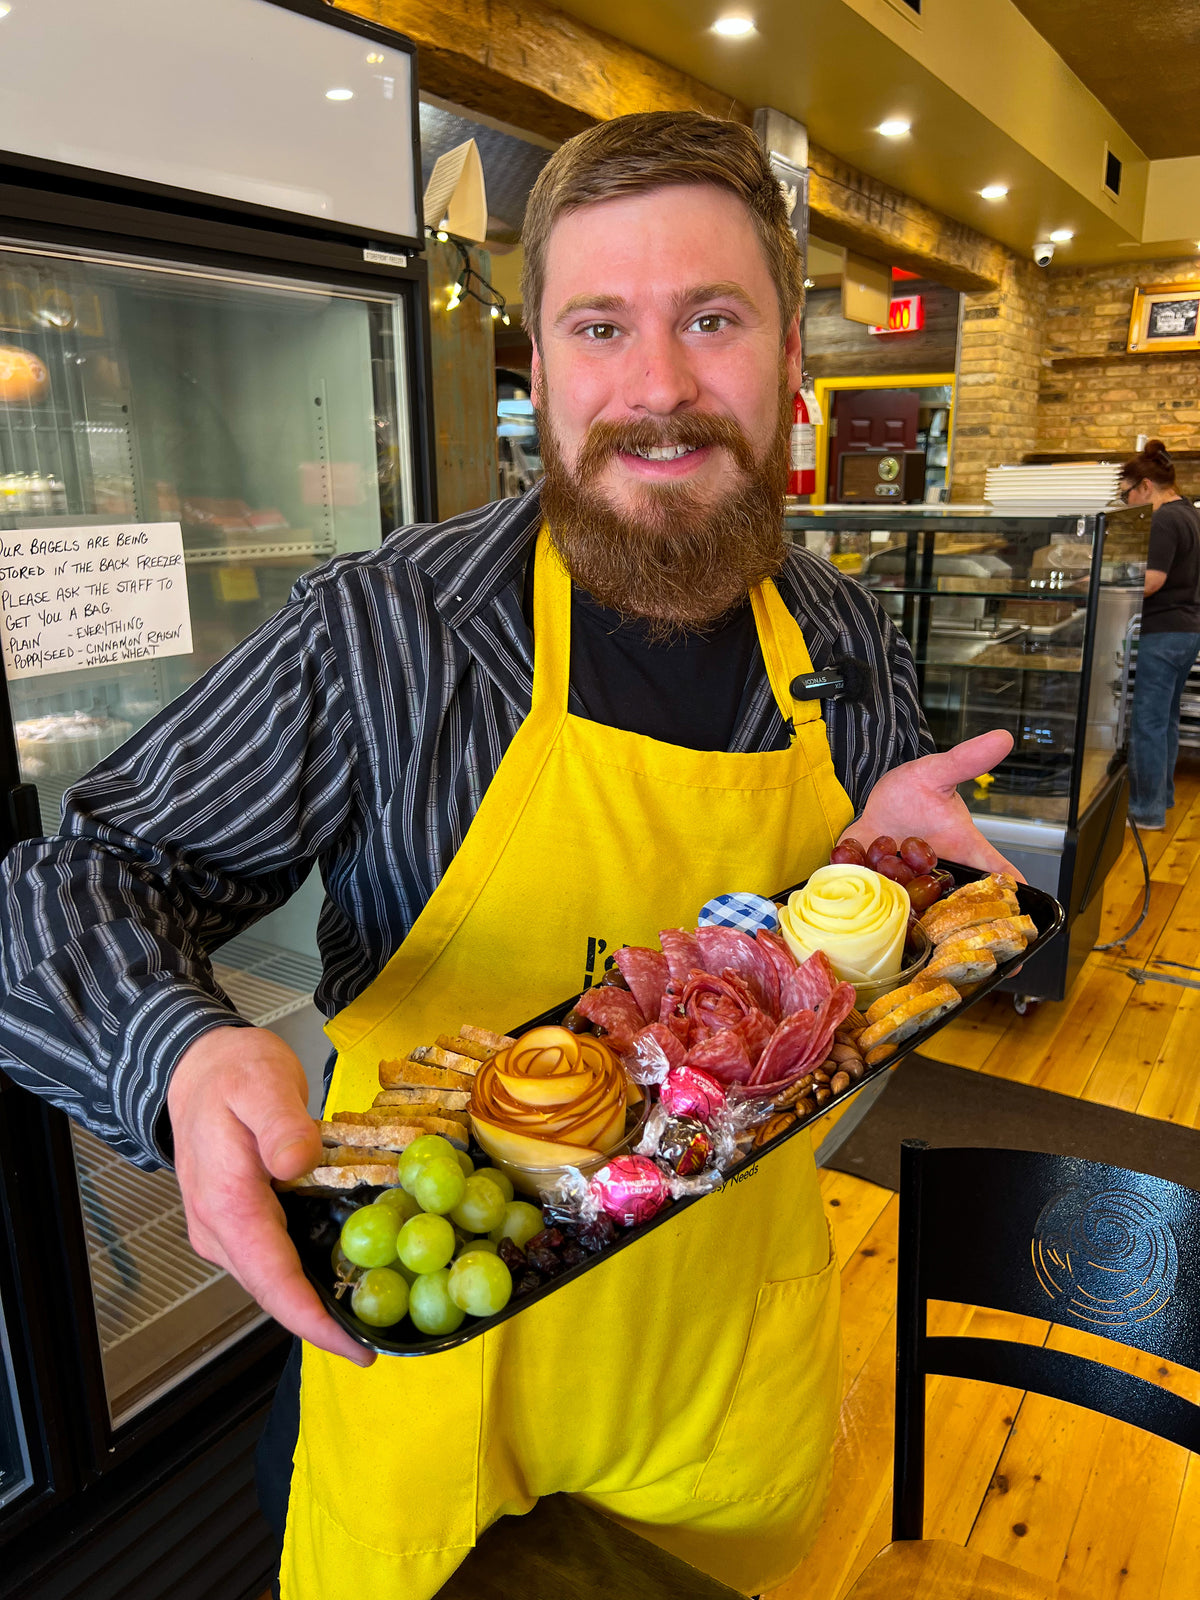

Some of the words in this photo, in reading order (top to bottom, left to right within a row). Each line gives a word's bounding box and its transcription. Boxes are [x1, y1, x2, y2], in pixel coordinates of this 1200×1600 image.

[30, 538, 80, 555] BAGELS
[87, 536, 110, 549] ARE
[116, 531, 149, 547] BEING
[0, 566, 45, 580] STORED
[54, 561, 68, 575] IN
[71, 561, 94, 574] THE
[99, 557, 129, 572] BACK
[1, 590, 51, 611] PLEASE
[56, 586, 80, 602] ASK
[85, 582, 110, 596] THE
[116, 578, 153, 594] STAFF
[157, 577, 173, 591] TO
[5, 614, 31, 631] GET
[38, 609, 62, 627] YOU
[69, 607, 78, 621] A
[86, 632, 143, 654] CINNAMON
[147, 624, 183, 643] RAISIN
[86, 653, 119, 666] WHOLE
[121, 644, 160, 660] WHEAT
[731, 1163, 760, 1188] Needs
[630, 1186, 654, 1196] CREAM
